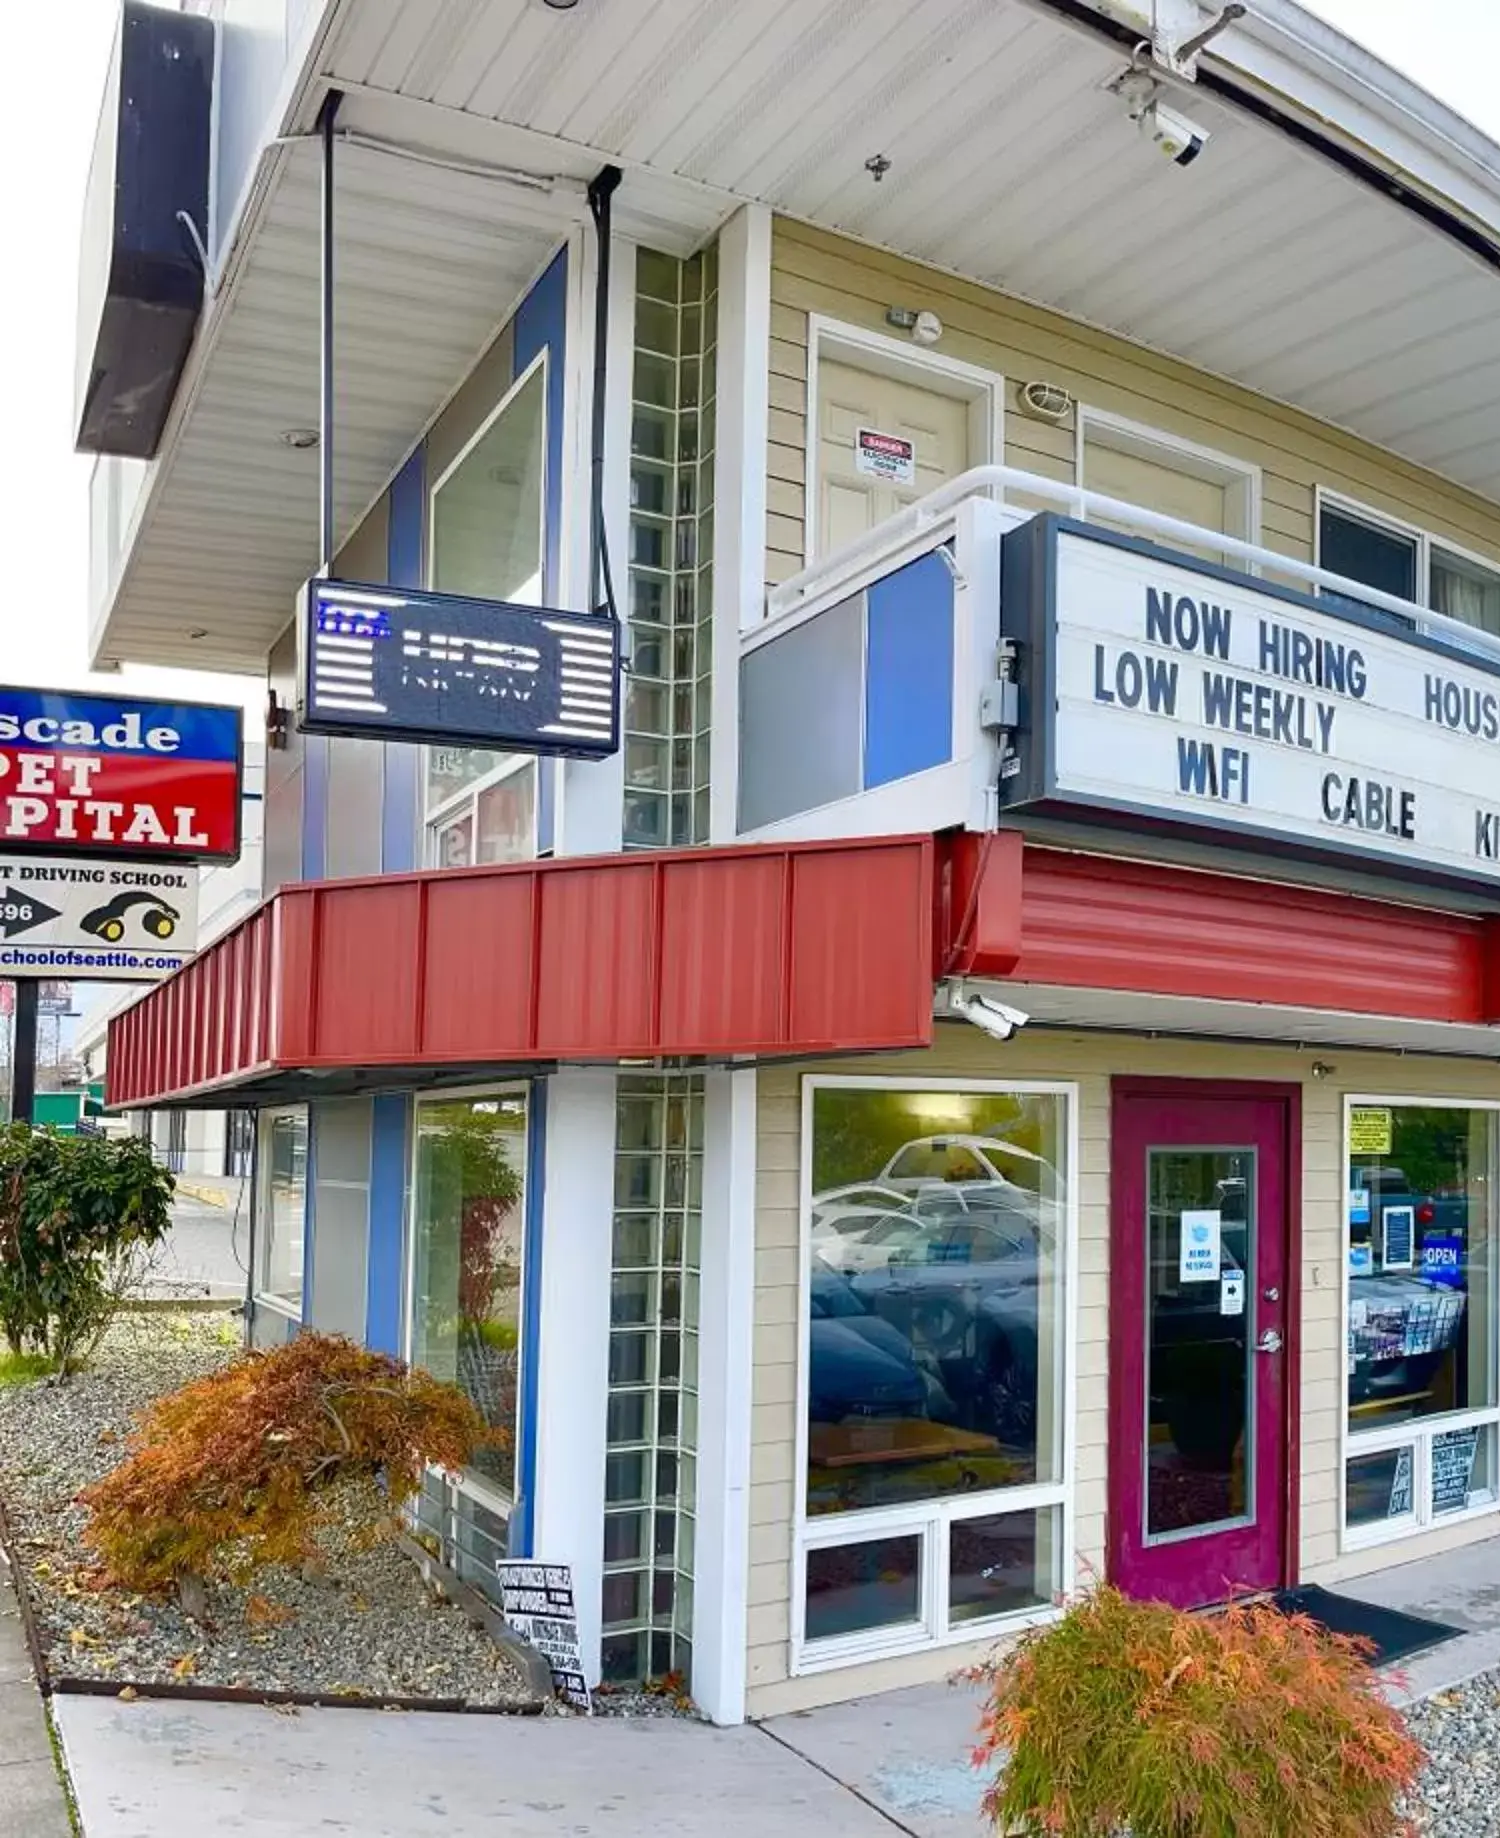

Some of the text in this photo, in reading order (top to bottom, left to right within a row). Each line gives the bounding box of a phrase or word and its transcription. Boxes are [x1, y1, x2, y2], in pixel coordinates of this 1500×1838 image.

[1145, 587, 1232, 660] NOW
[1259, 622, 1367, 698] HIRING
[1095, 645, 1335, 754] LOW WEEKLY
[0, 752, 101, 796] ET
[1322, 773, 1415, 840] CABLE
[20, 867, 104, 883] DRIVING
[110, 871, 187, 888] SCHOOL
[1427, 1247, 1457, 1265] OPEN
